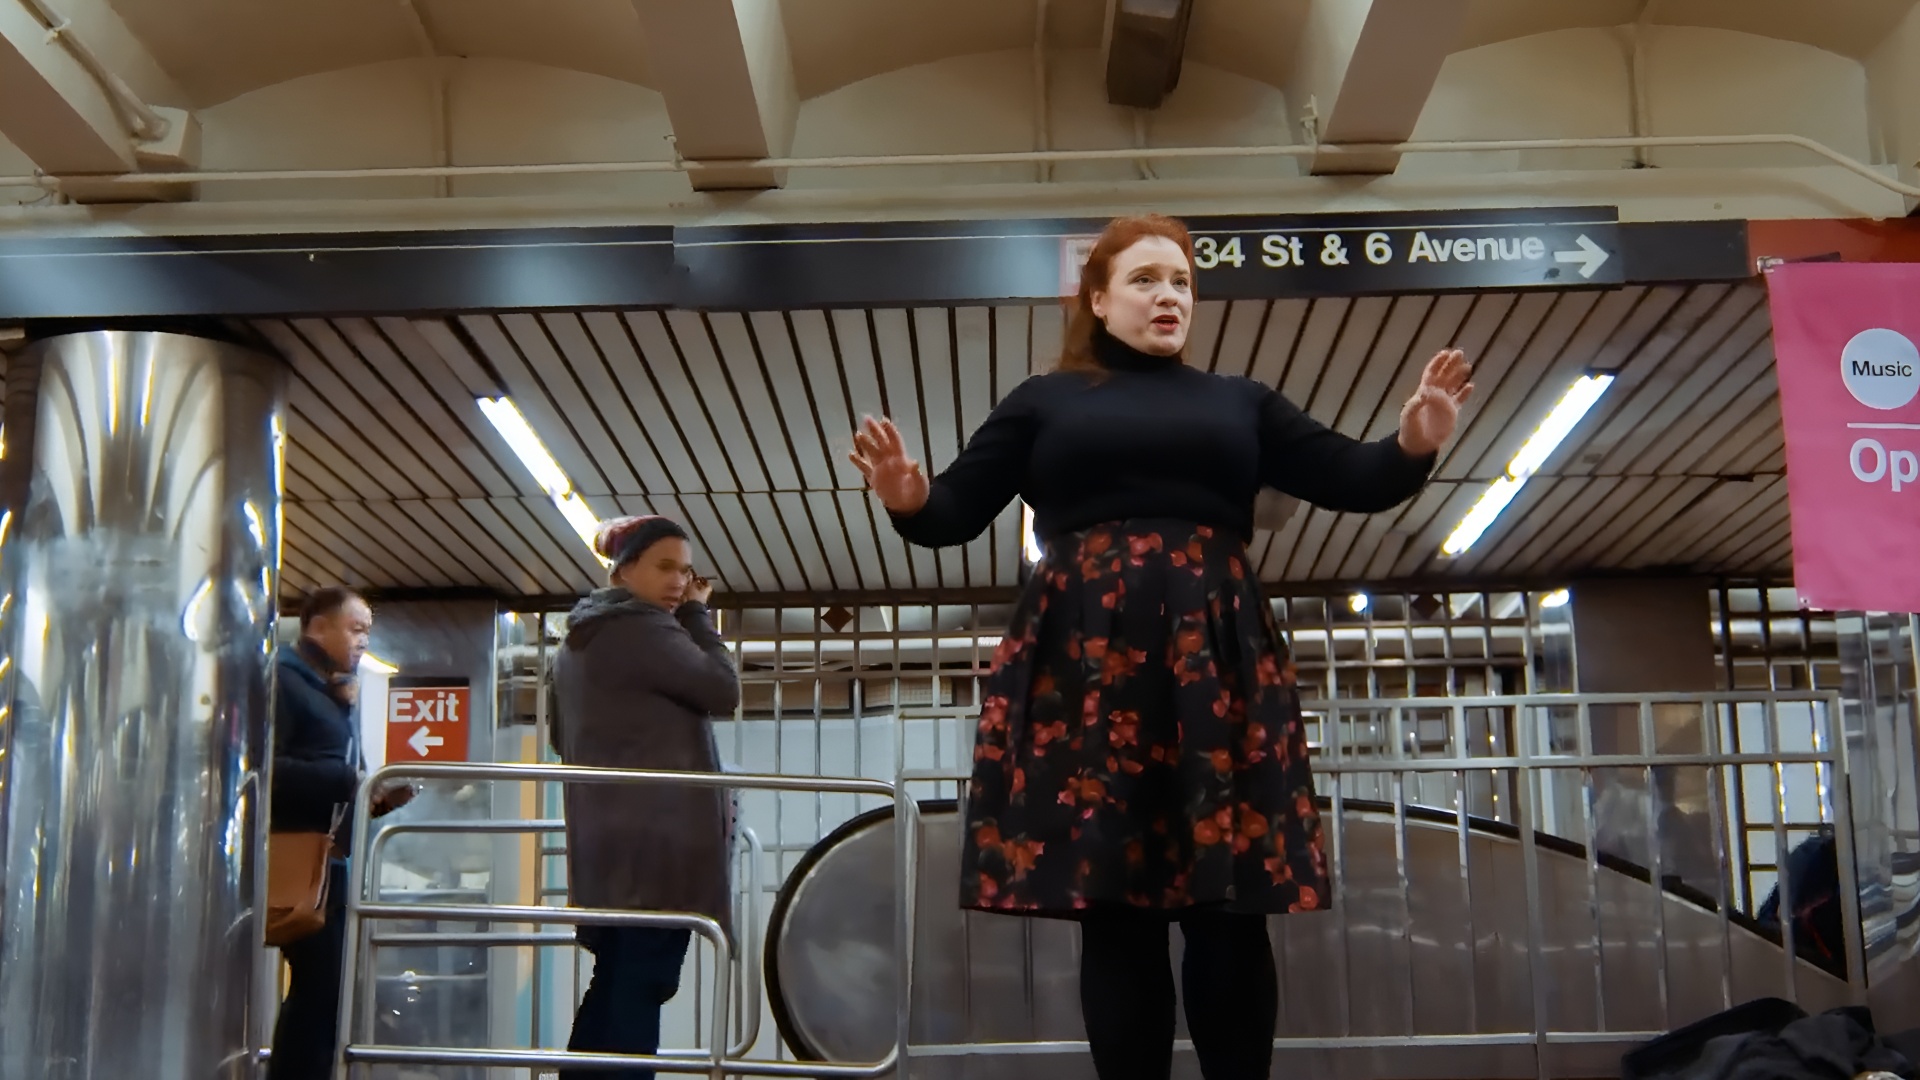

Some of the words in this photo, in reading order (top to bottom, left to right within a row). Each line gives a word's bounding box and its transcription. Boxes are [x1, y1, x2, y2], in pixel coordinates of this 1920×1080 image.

[1194, 236, 1246, 269] 34
[1262, 234, 1305, 267] St
[1320, 233, 1350, 266] &
[1365, 231, 1393, 265] 6
[1408, 231, 1546, 263] Avenue
[1852, 360, 1912, 377] Music
[1850, 438, 1919, 492] Op
[388, 691, 460, 723] Exit
